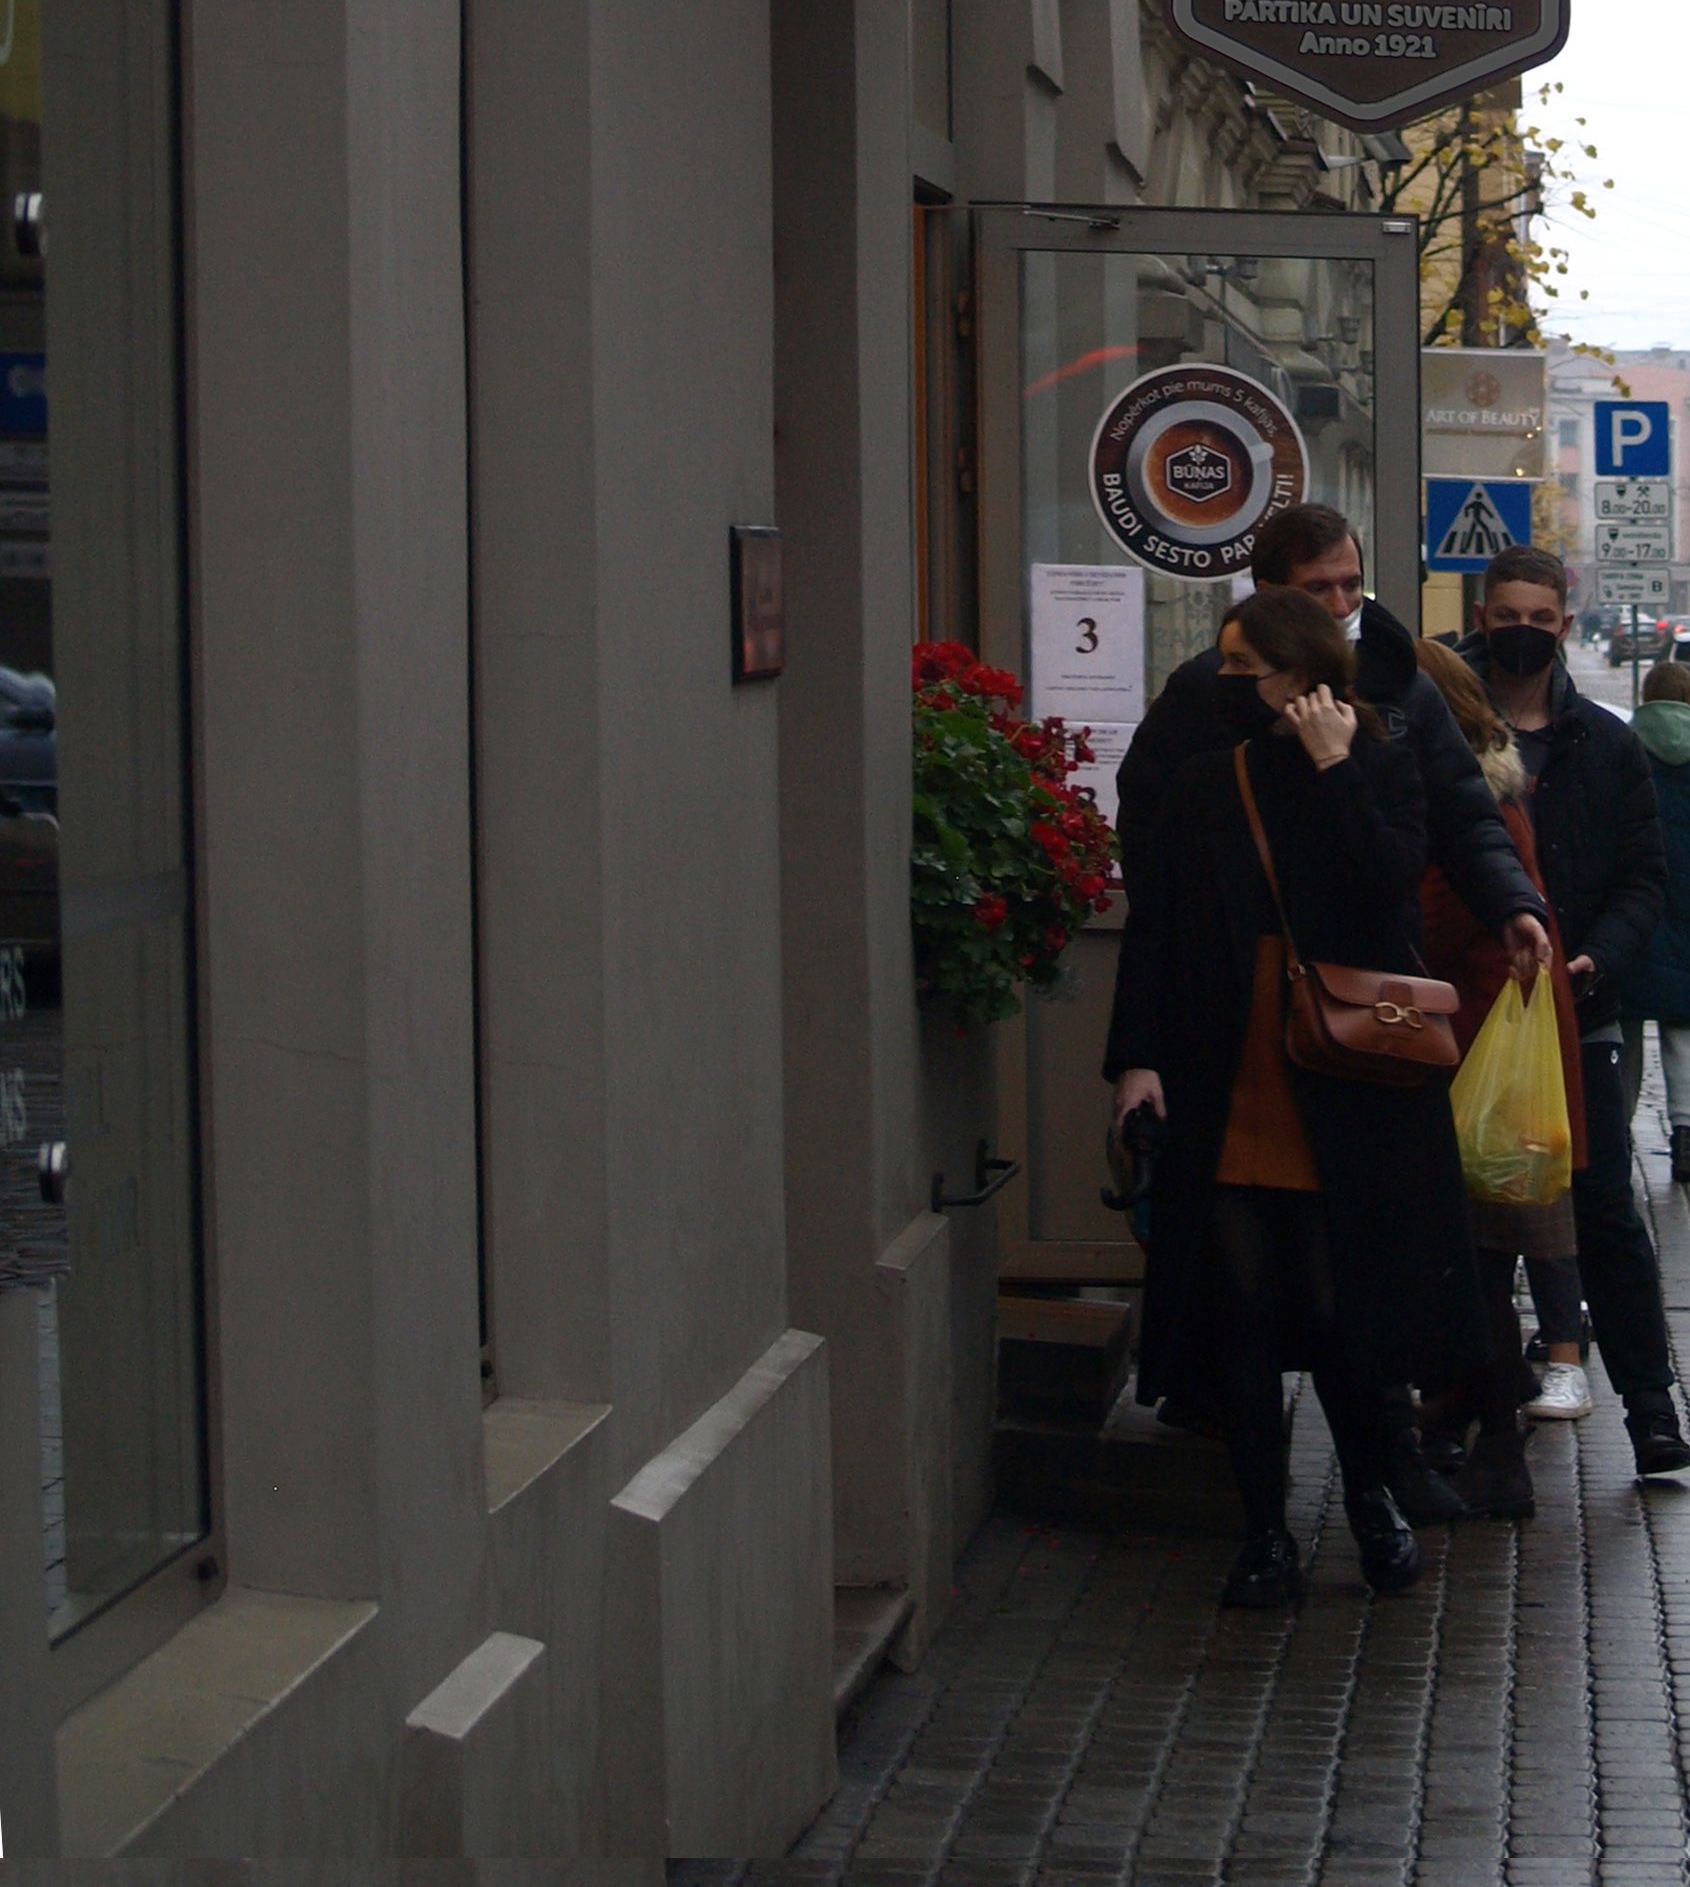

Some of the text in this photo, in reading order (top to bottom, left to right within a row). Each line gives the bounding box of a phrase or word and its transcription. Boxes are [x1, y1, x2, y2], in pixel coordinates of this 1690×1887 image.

[1340, 2, 1382, 27] UN
[1387, 1, 1511, 31] SUVENĪRI
[1300, 31, 1437, 59] Anno 1921
[1110, 389, 1163, 442] Nopērkot
[1162, 381, 1184, 401] pie
[1186, 380, 1231, 397] mums
[1234, 390, 1245, 402] 5
[1426, 409, 1540, 426] ART OF BEAUTY
[1611, 410, 1652, 467] P
[1173, 463, 1225, 481] BŪŅAS
[1102, 473, 1142, 537] BAUDI
[1143, 536, 1211, 568] SESTO
[1601, 500, 1666, 515] 8.00-20.00
[1601, 544, 1665, 559] 9.00-17.00
[1652, 581, 1663, 592] B
[1075, 617, 1099, 654] 3
